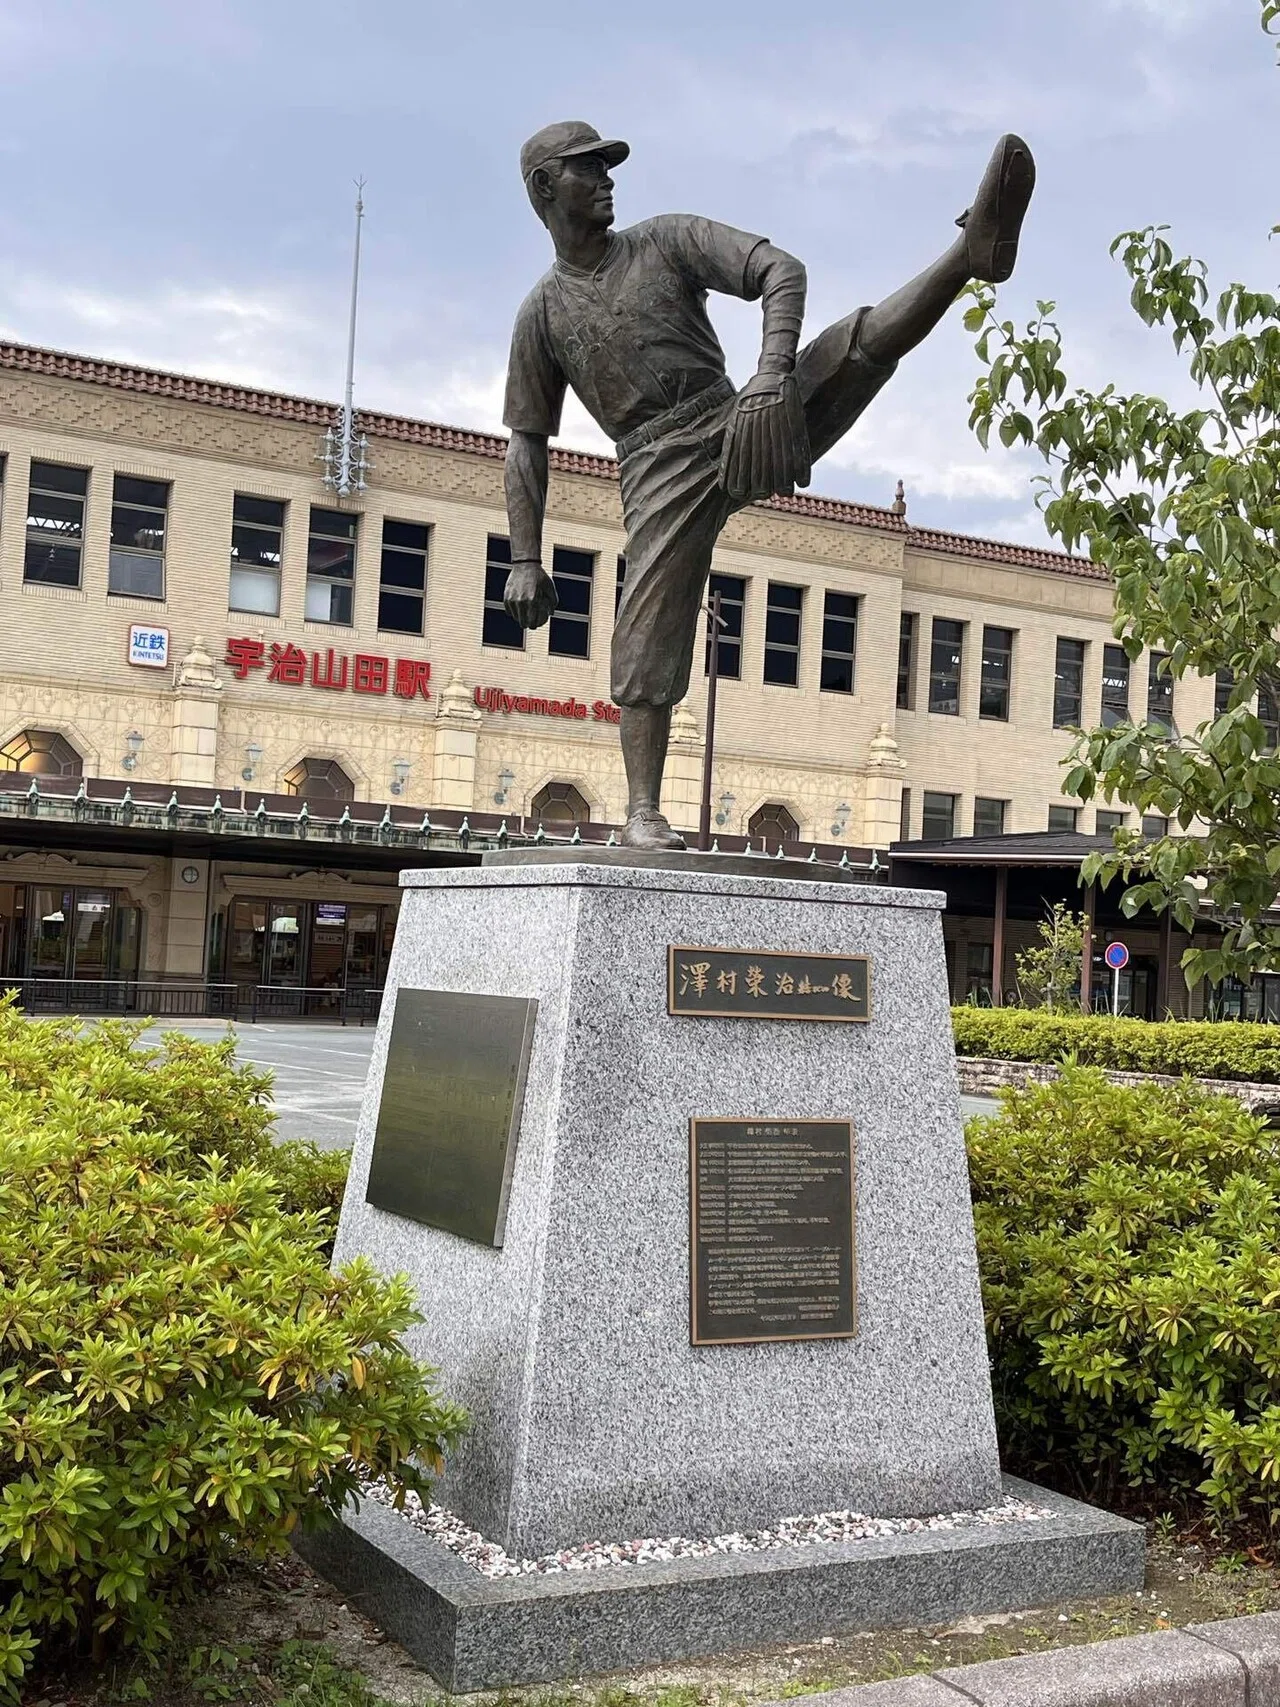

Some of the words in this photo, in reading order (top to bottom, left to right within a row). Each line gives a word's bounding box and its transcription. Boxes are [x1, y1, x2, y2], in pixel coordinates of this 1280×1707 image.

[133, 631, 165, 651] 近鉄
[225, 637, 431, 700] 宇治山田駅
[474, 686, 587, 719] Ujiyamada
